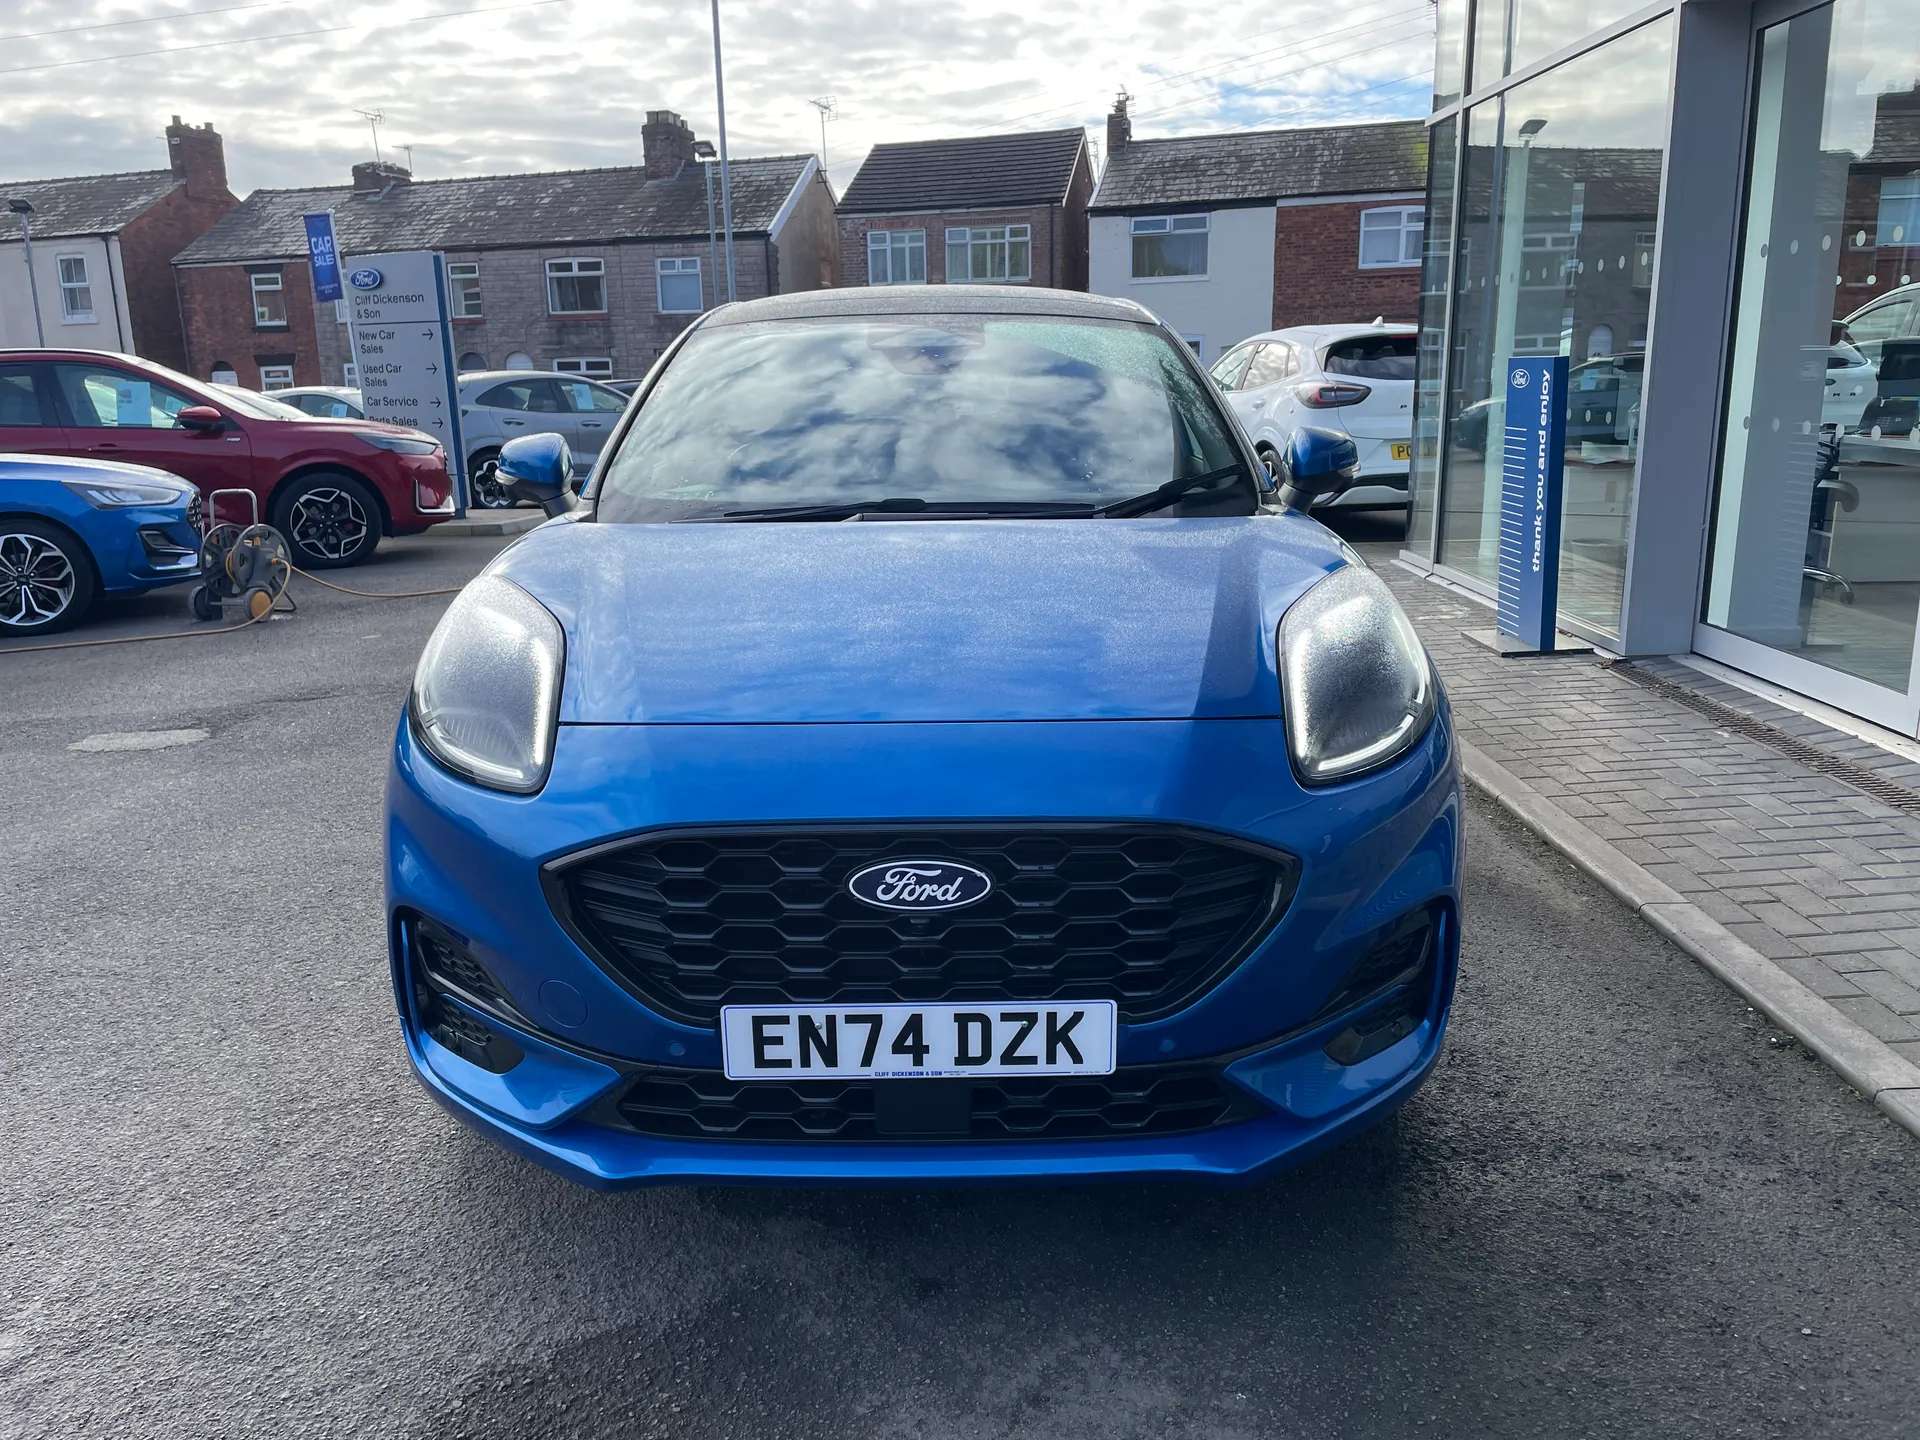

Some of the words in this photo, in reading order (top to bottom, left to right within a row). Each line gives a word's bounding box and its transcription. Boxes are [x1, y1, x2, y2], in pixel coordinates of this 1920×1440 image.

[311, 235, 333, 255] CAR
[355, 271, 374, 286] Ford
[354, 294, 371, 306] Cliff
[372, 293, 425, 305] Dickenson
[356, 309, 363, 320] &
[363, 308, 381, 319] Son
[359, 330, 378, 341] New
[379, 329, 396, 340] Car
[360, 343, 384, 354] Sales
[362, 363, 384, 374] Used
[385, 363, 402, 374] Car
[364, 377, 388, 388] Sales
[367, 396, 381, 407] Car
[383, 396, 419, 407] Service
[1540, 369, 1551, 427] enjoy
[391, 415, 418, 427] Sales
[1538, 429, 1546, 471] and
[1535, 476, 1544, 511] you
[1532, 514, 1542, 573] thank
[876, 867, 963, 901] Ford
[751, 1013, 930, 1069] EN74
[953, 1011, 1085, 1067] DZK
